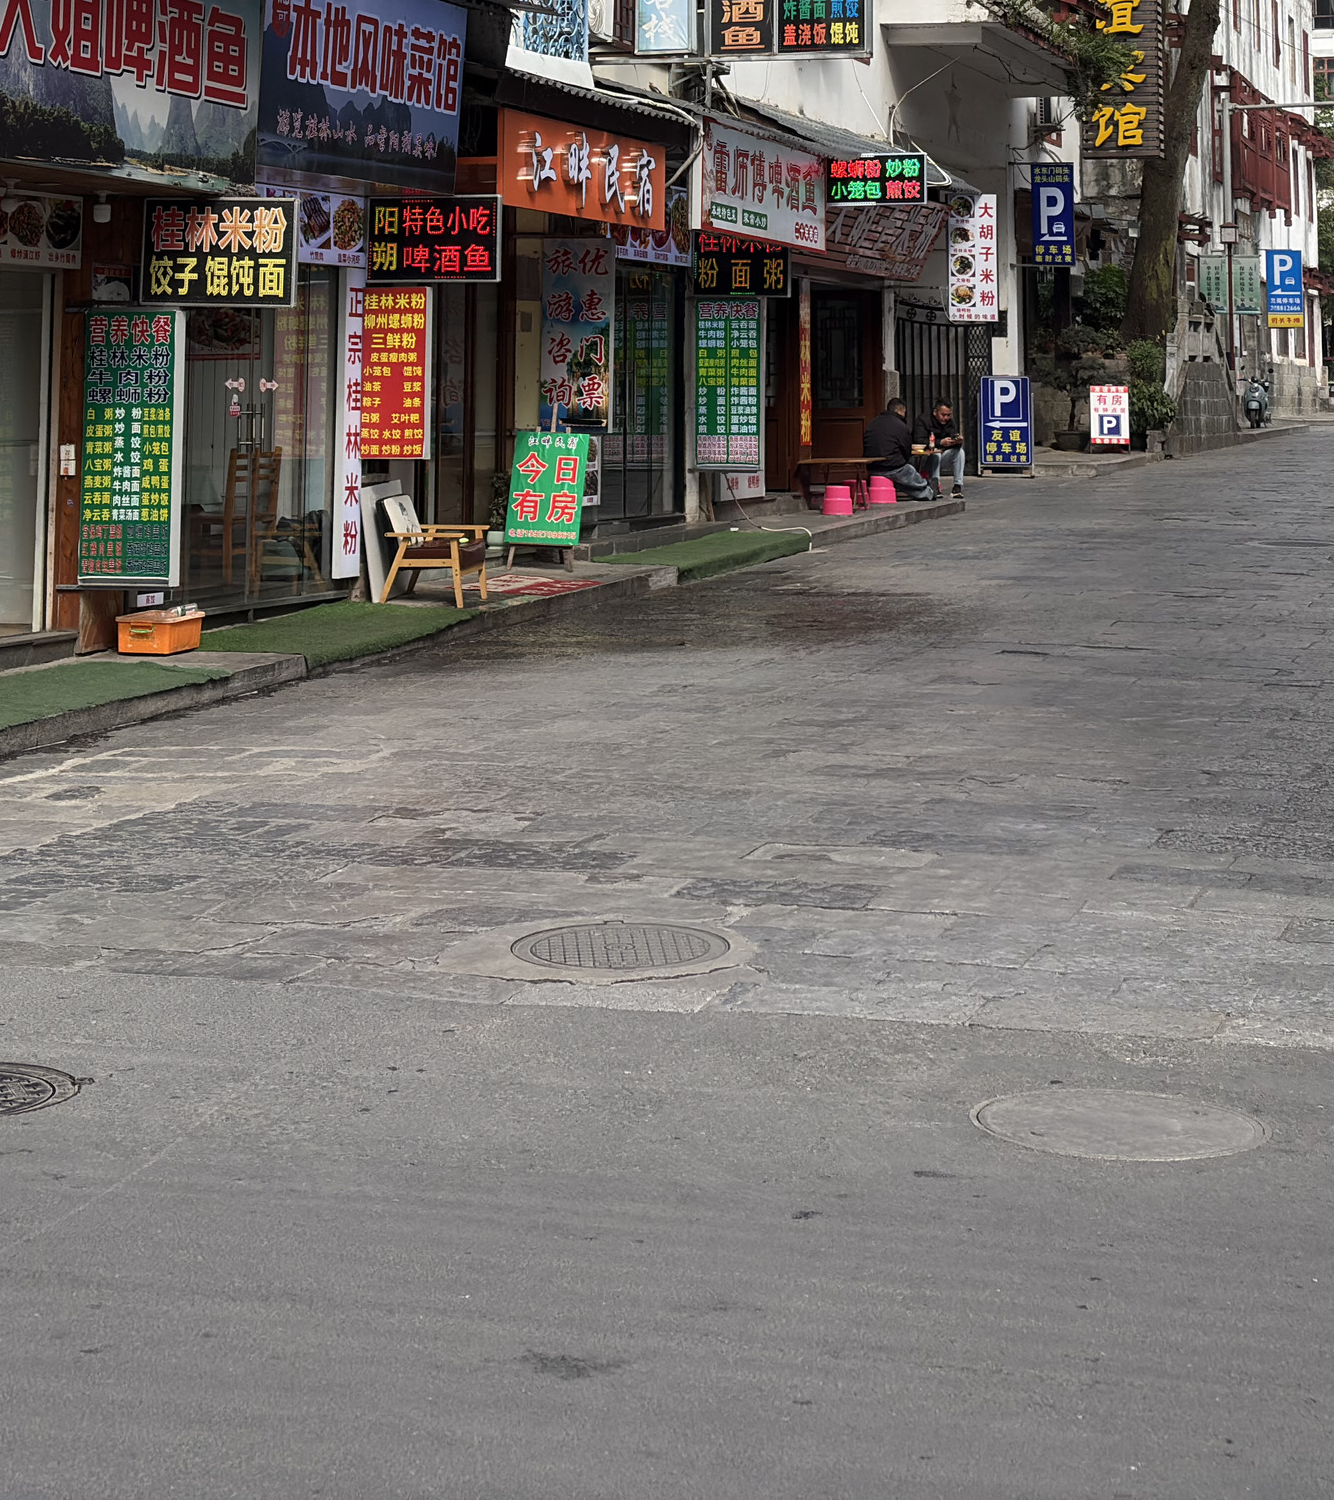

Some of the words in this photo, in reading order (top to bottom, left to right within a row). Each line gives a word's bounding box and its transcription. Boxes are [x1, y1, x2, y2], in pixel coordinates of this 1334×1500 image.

[783, 22, 827, 46] 盖浇饭
[830, 21, 859, 45] 馄饨
[532, 131, 655, 218] 江畔民宿
[714, 139, 817, 216] 雷师傅啤酒鱼
[885, 159, 920, 178] 炒粉
[830, 181, 882, 200] 小笼包
[885, 180, 921, 199] 煎饺
[151, 206, 288, 254] 桂林米粉
[402, 206, 491, 237] 特色小吃
[403, 244, 492, 274] 啤酒鱼
[978, 203, 995, 307] 大胡子米粉
[1035, 245, 1072, 254] 停车场
[149, 255, 199, 296] 饺子
[205, 255, 287, 298] 馄饨面
[364, 293, 426, 310] 桂林米粉
[699, 302, 758, 319] 营养快餐
[89, 316, 171, 345] 营养快餐
[364, 313, 425, 329] 柳州螺蛳粉
[541, 247, 578, 408] 旅游咨询
[577, 247, 610, 411] 优惠门票
[371, 333, 417, 349] 三鲜粉
[89, 346, 171, 368] 桂林米粉
[370, 352, 417, 363] 皮蛋瘦肉粥
[87, 369, 170, 386] 牛肉粉
[363, 366, 391, 376] 小笼包
[403, 366, 422, 376] 馄饨
[87, 387, 170, 404] 螺蛳粉
[363, 382, 382, 392] 油茶
[403, 382, 422, 392] 豆浆
[403, 397, 422, 407] 油条
[994, 380, 1017, 417] P
[1097, 394, 1123, 405] 有房
[343, 286, 363, 555] 正宗桂林米粉
[361, 413, 380, 423] 白粥
[382, 429, 401, 439] 水饺
[404, 429, 423, 439] 煎饺
[991, 430, 1021, 441] 友谊
[360, 445, 379, 455] 炒面
[381, 445, 400, 455] 炒粉
[403, 445, 422, 455] 炒饭
[986, 442, 1027, 454] 停车场
[516, 452, 579, 484] 今日
[83, 492, 111, 505] 云吞面
[113, 480, 140, 492] 牛肉面
[141, 492, 169, 505] 蛋炒饭
[113, 494, 140, 507] 肉丝面
[512, 488, 577, 524] 有房
